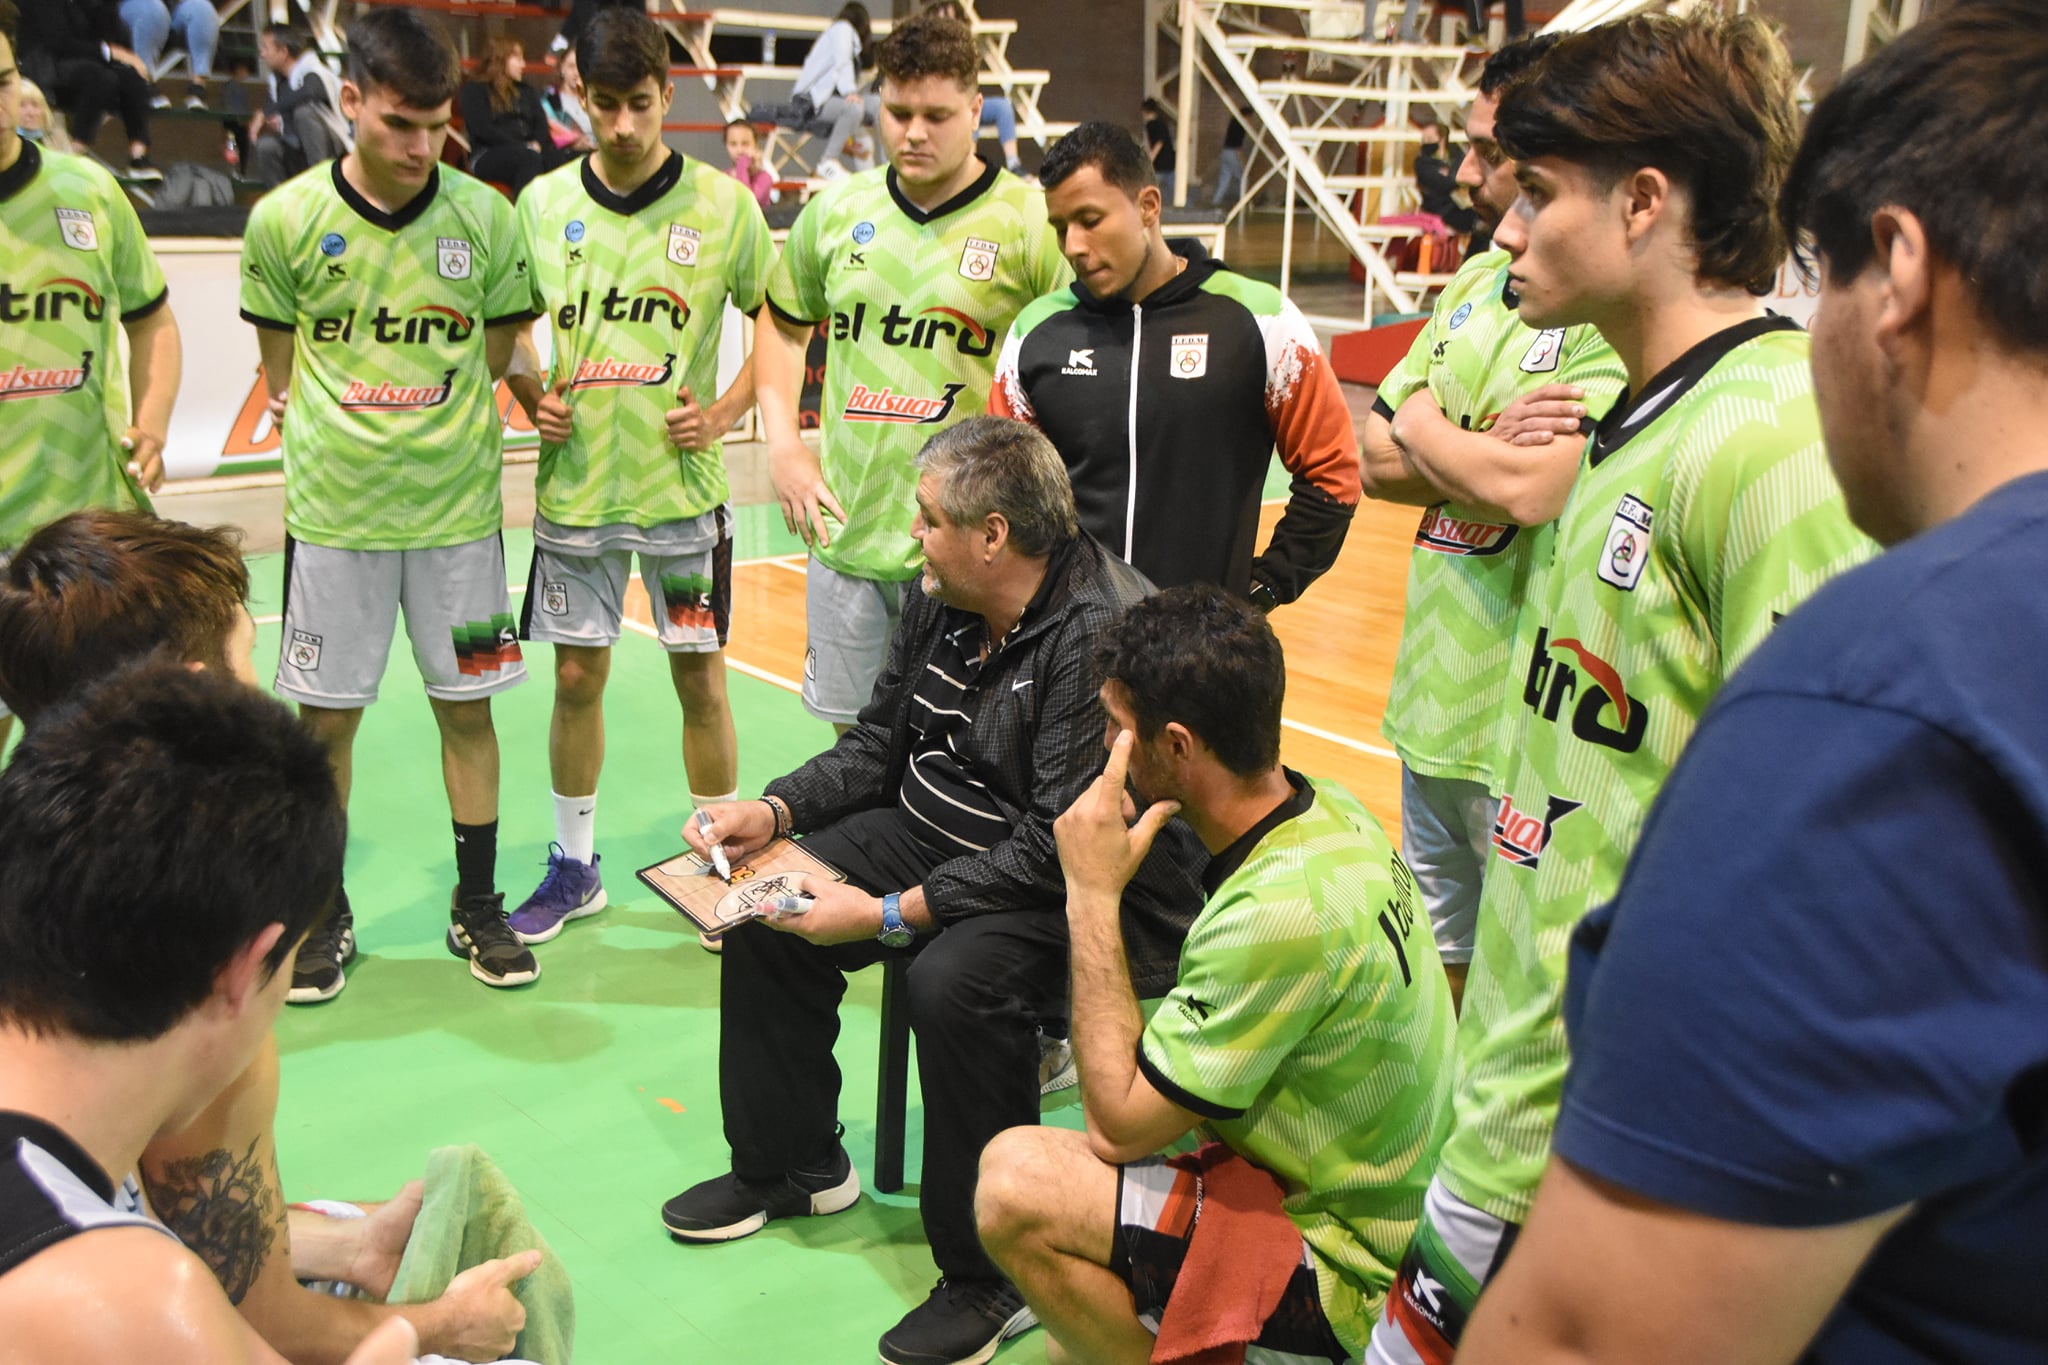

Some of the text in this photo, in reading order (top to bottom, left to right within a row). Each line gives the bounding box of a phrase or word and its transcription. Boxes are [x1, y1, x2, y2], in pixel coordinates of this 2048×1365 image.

[313, 304, 475, 344] el tiro
[558, 286, 691, 330] el tiro
[834, 302, 996, 357] el tiro
[1061, 367, 1098, 376] KALCOMAX
[1419, 506, 1505, 547] alsuar
